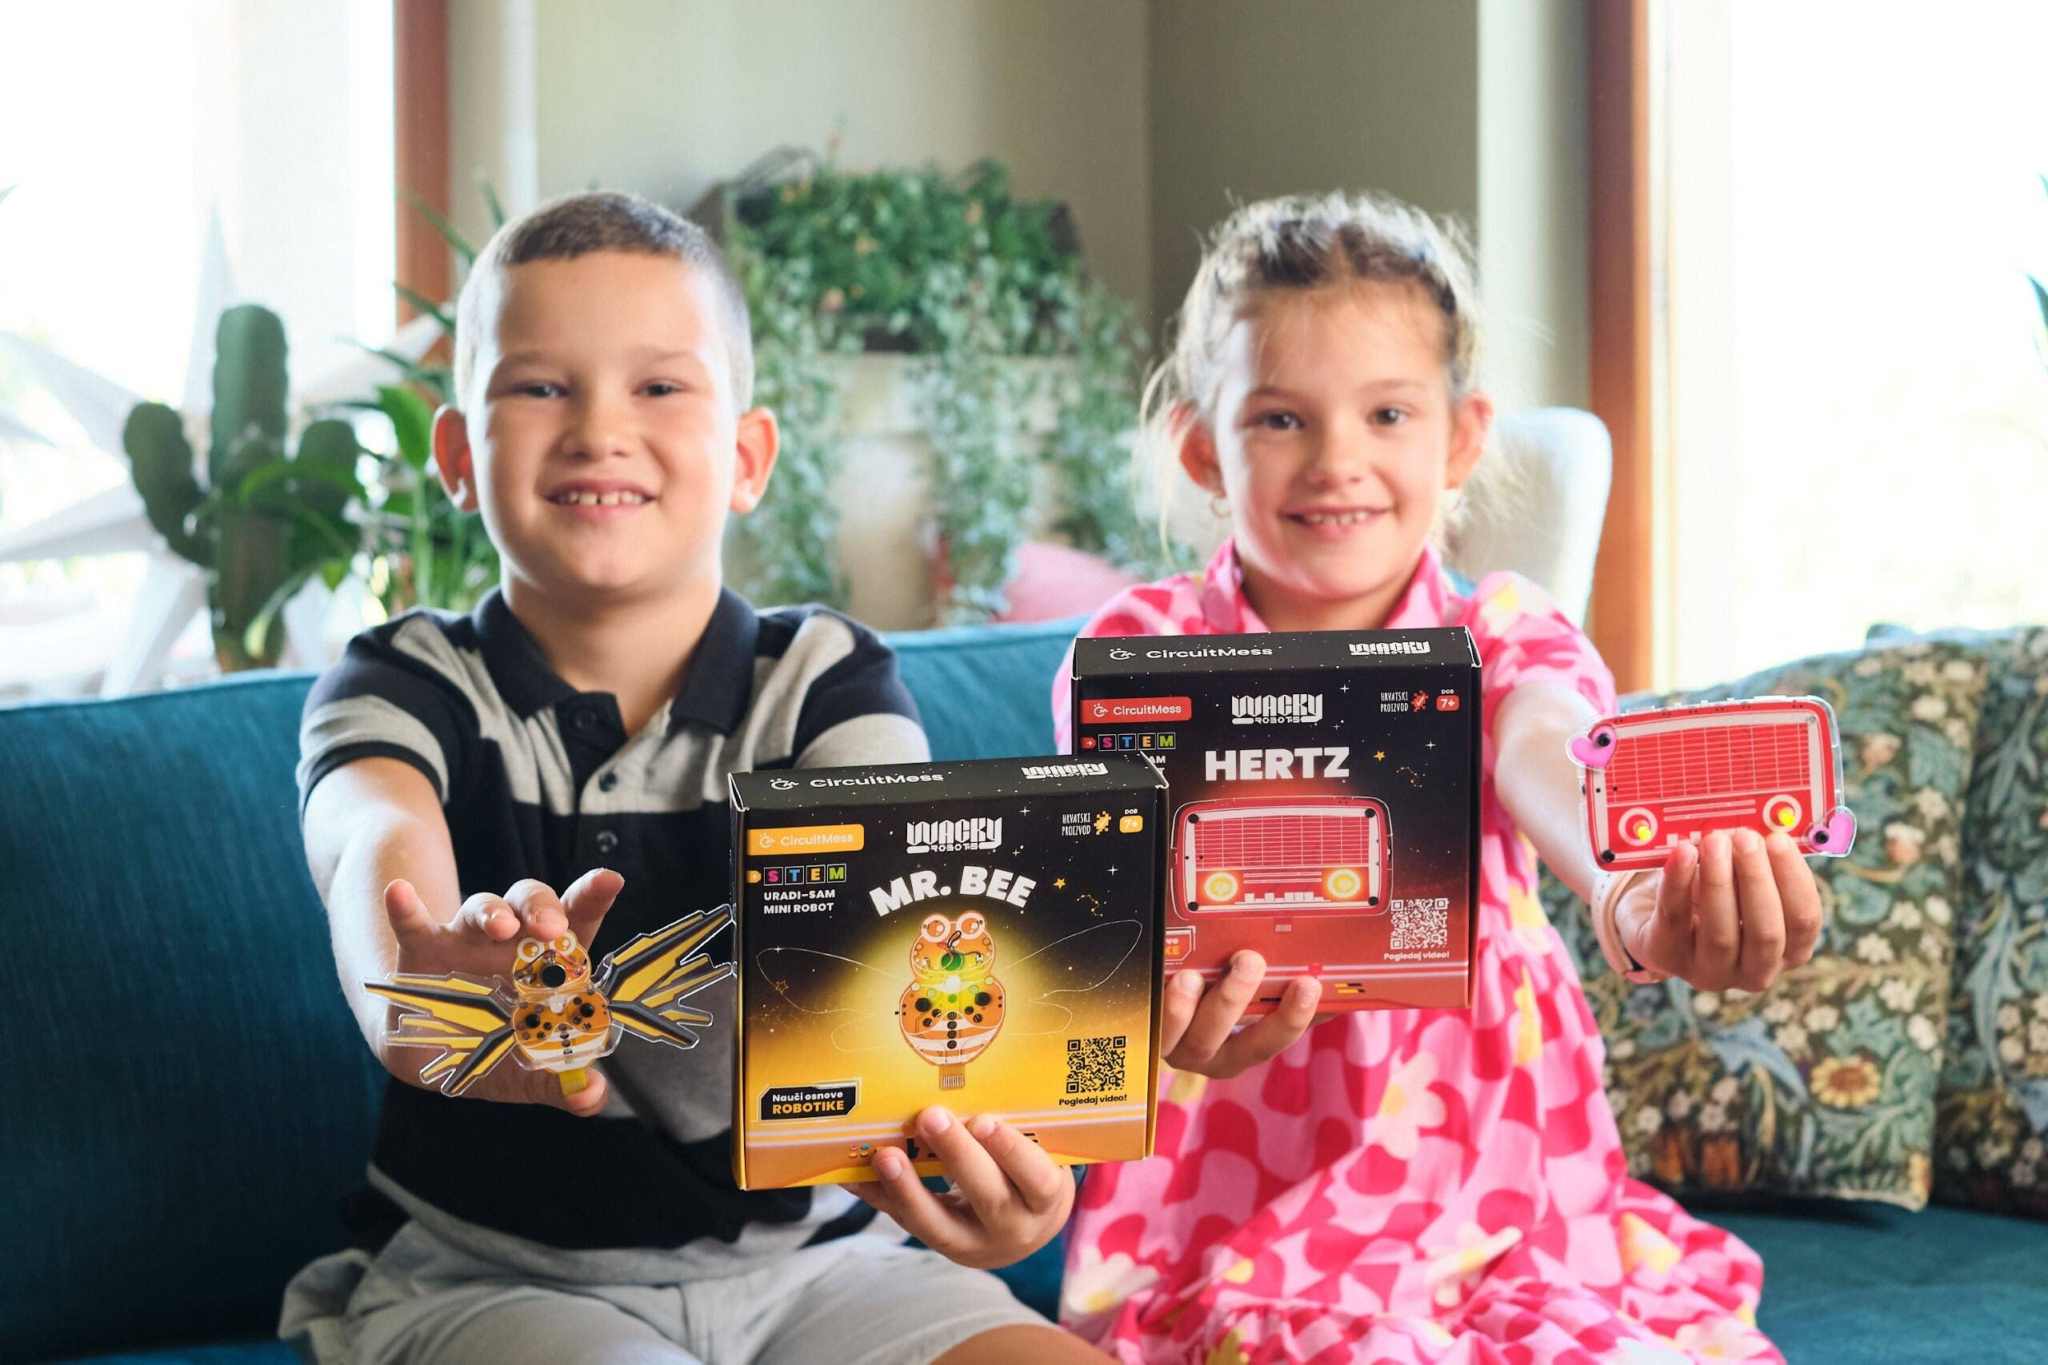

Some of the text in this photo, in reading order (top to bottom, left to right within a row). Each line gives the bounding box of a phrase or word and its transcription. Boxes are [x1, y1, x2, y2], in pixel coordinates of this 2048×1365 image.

[1146, 647, 1273, 659] CircuitMess
[1380, 691, 1409, 702] HRVATSKI
[1231, 693, 1323, 723] WACKY
[1380, 702, 1409, 713] PROIZVOD
[1440, 698, 1455, 709] 7+
[1112, 704, 1182, 716] CircuitMess
[1205, 746, 1350, 781] HERTZ
[809, 773, 945, 788] CircuitMess
[1062, 813, 1091, 824] HRVATSKI
[906, 816, 1003, 851] WACKY
[1061, 825, 1091, 836] PROIZVOD
[780, 833, 854, 848] CircuitMess
[763, 889, 836, 901] URADI-SAM
[868, 865, 1037, 917] MR. BEE
[763, 902, 835, 914] MINI ROBOT
[1383, 950, 1450, 962] Pogledaj video!
[772, 1091, 844, 1102] Nauči osnove
[1058, 1094, 1128, 1107] Pogledaj video!
[772, 1100, 845, 1115] ROBOTIKE
